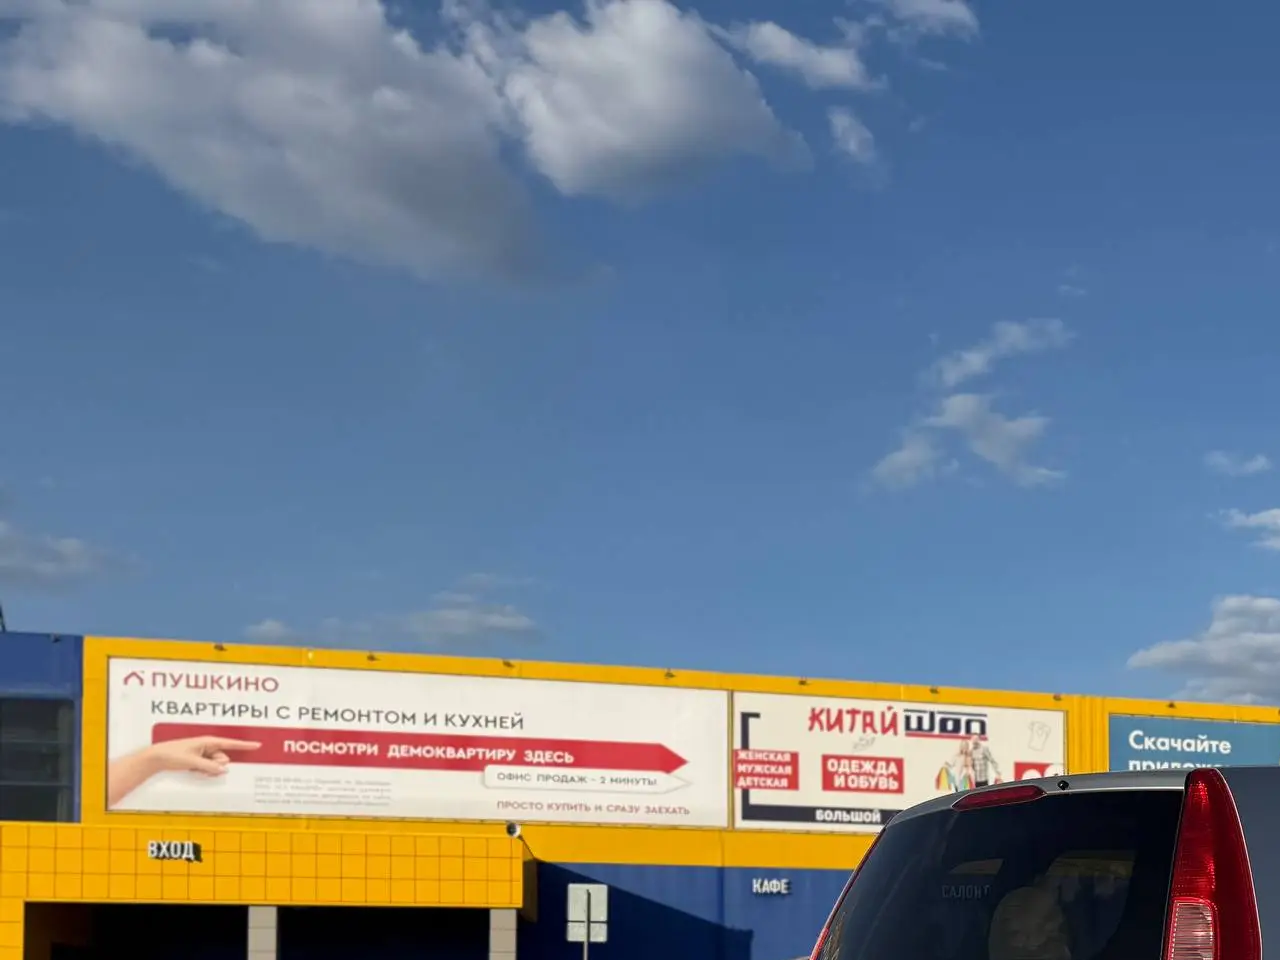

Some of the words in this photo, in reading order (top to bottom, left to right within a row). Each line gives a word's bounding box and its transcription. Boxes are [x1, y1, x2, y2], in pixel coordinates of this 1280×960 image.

[151, 671, 280, 692] ПУШКИНО
[151, 700, 269, 719] КВАРТИРЫ
[276, 705, 291, 720] С
[298, 706, 417, 725] РЕМОНТОМ
[424, 712, 438, 727] И
[444, 711, 525, 730] КУХНЕЙ
[808, 705, 899, 736] КИТАЙ
[1128, 729, 1232, 755] Скачайте
[283, 740, 379, 757] ПОСМОТРИ
[387, 743, 516, 762] ДЕМОКВАРТИРУ
[524, 749, 575, 765] ЗДЕСЬ
[737, 750, 791, 762] ЖЕНСКАЯ
[737, 763, 793, 775] МУЖСКАЯ
[827, 759, 899, 777] ОДЕЖДА
[496, 771, 532, 783] ОФИС
[536, 773, 588, 785] ПРОДАЖ
[610, 776, 658, 786] МИНУТЫ
[737, 775, 788, 788] ДЕТСКАЯ
[834, 776, 845, 788] И
[847, 776, 899, 791] ОБУВЬ
[496, 800, 544, 812] ПРОСТО
[547, 802, 591, 813] КУПИТЬ
[594, 804, 603, 813] И
[606, 804, 640, 815] СРАЗУ
[644, 805, 691, 817] ЗАЕХАТЬ
[815, 808, 882, 825] БОЛЬШОЙ
[147, 839, 195, 861] ВХОД
[752, 877, 789, 894] КАФЕ
